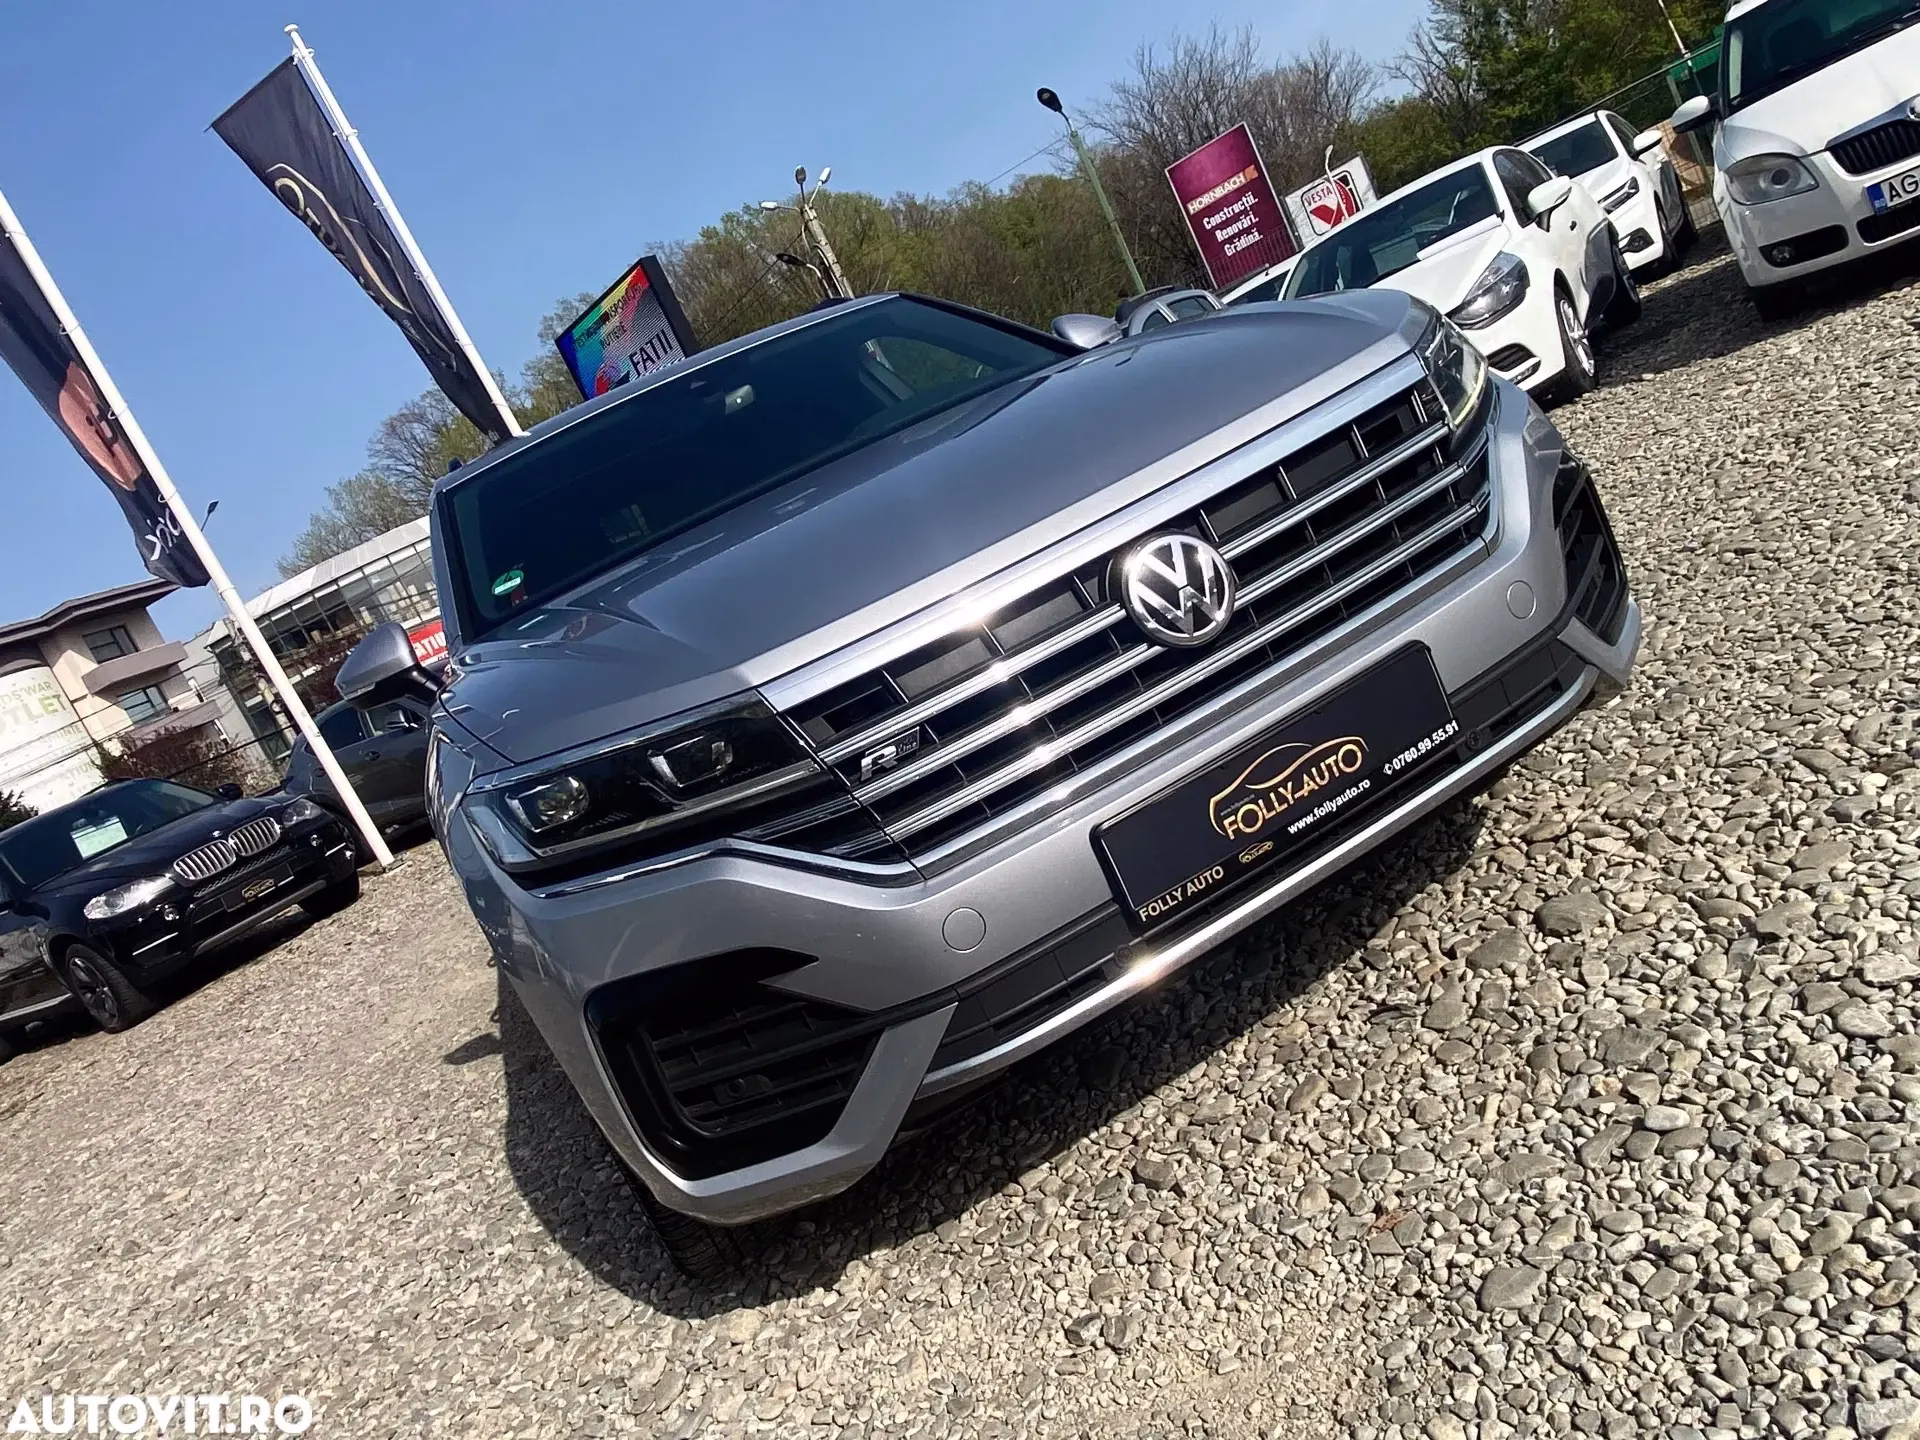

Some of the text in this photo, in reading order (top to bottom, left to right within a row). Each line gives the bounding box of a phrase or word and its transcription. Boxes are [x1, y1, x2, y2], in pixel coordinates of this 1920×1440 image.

[1188, 174, 1246, 214] HORNBACH
[1305, 186, 1332, 206] VESTA
[1215, 215, 1259, 242] Renovări.
[1392, 719, 1459, 770] 0760.99.55.91
[1288, 778, 1371, 834] www.follyauto.ro
[1138, 865, 1225, 922] FOLLY AUTO
